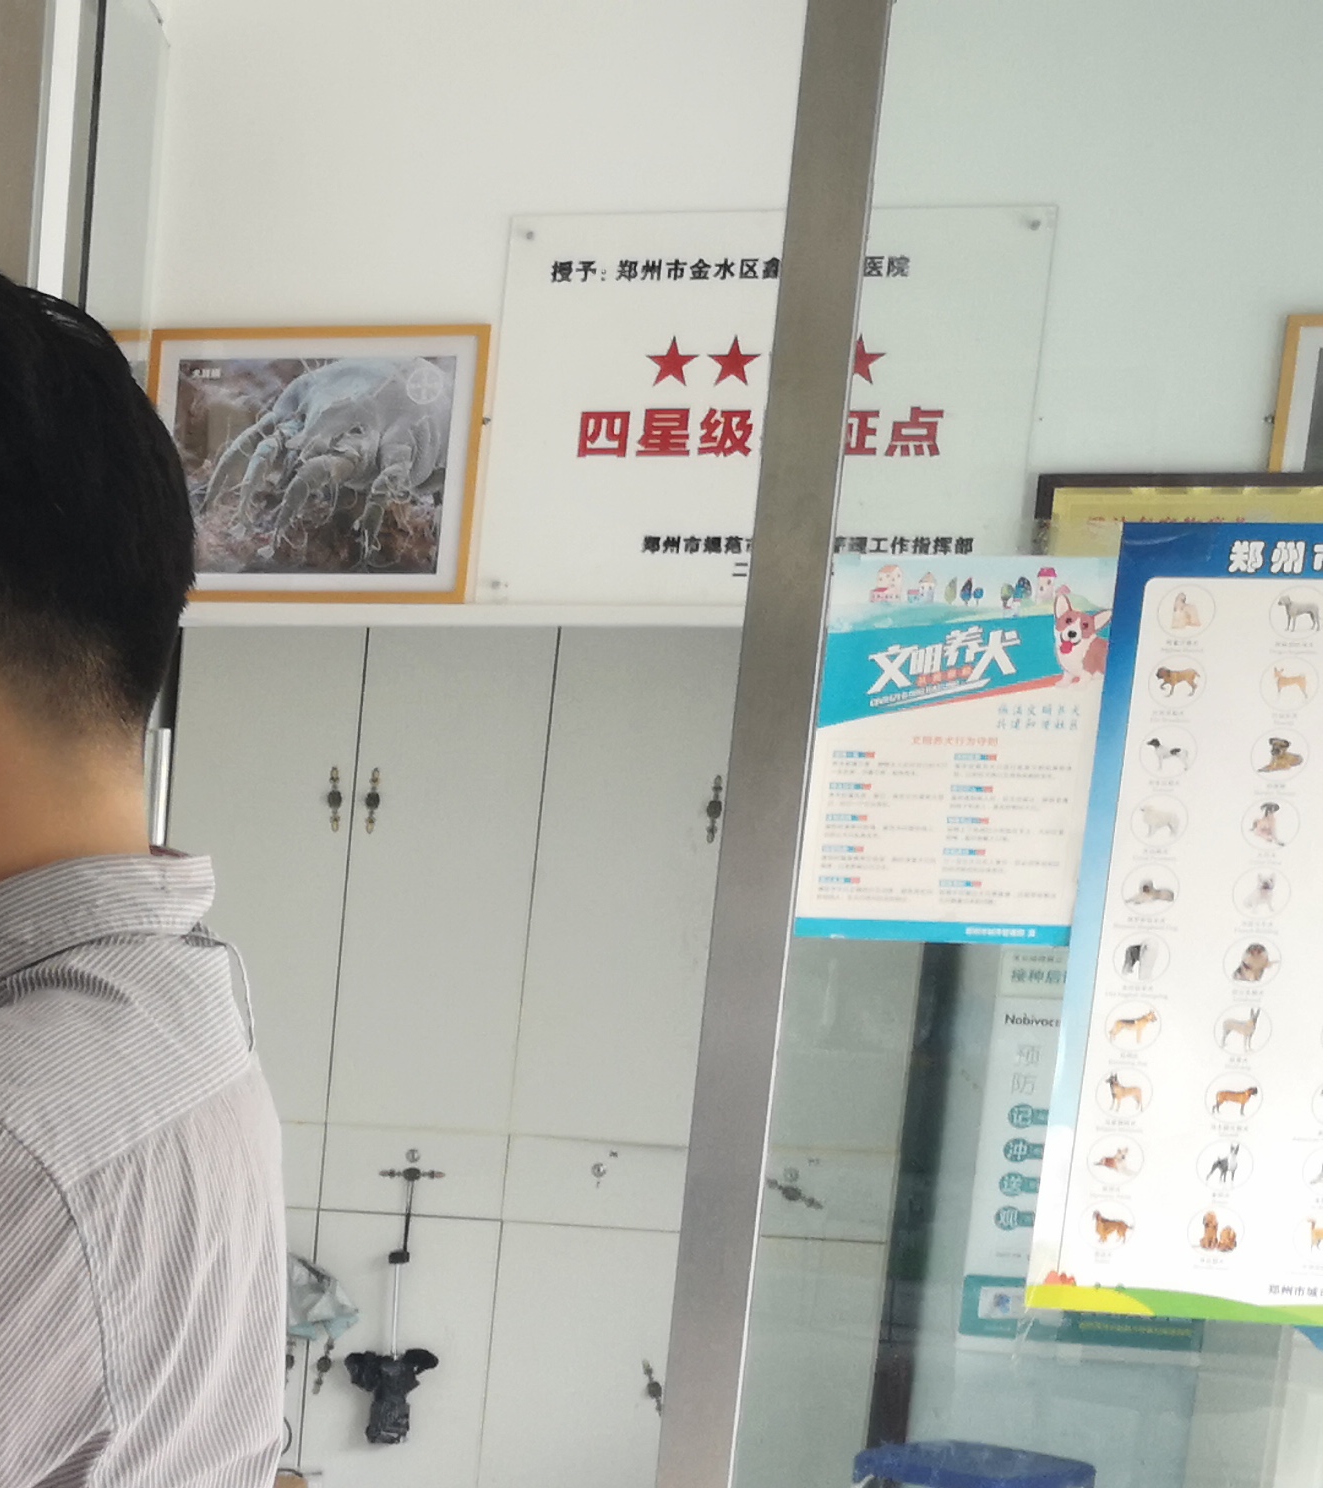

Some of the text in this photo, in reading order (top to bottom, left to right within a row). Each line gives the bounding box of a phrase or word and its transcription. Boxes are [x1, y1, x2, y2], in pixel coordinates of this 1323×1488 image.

[1227, 540, 1323, 575] 郑州
[866, 625, 1022, 695] 文明养犬
[1268, 1284, 1323, 1298] 郑州市城
